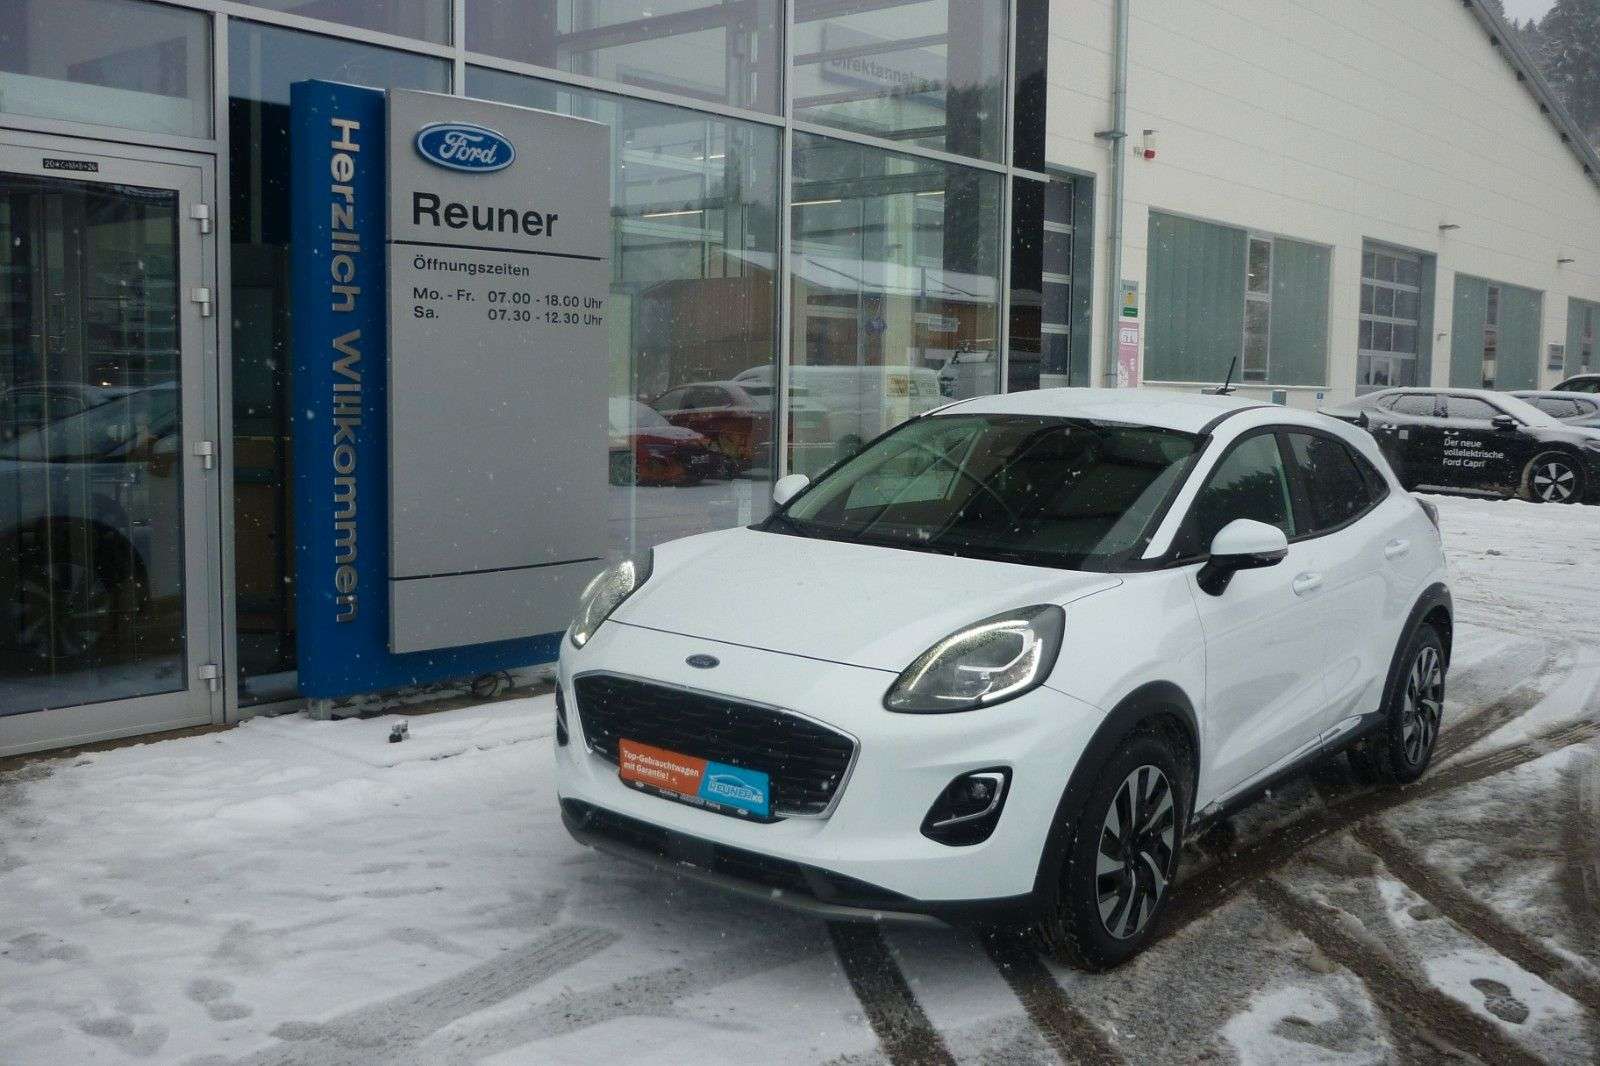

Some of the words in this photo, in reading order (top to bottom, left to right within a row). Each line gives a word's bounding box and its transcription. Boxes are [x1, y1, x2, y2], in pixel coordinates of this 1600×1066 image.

[439, 131, 498, 164] Ford
[330, 118, 360, 312] Herzlich
[412, 191, 558, 237] Reuner
[413, 254, 530, 277] Öffnungszeiten
[413, 287, 444, 301] Mo.
[457, 289, 475, 302] Fr.
[488, 290, 531, 305] 07.00
[545, 294, 580, 308] 18.00
[584, 299, 603, 310] Uhr
[413, 305, 439, 319] Sa.
[488, 309, 531, 322] 07.30
[545, 312, 580, 325] 12.30
[584, 316, 603, 326] Uhr
[1444, 438, 1458, 447] Der
[1460, 440, 1482, 448] neue
[1444, 449, 1504, 459] vollelektrische
[1443, 458, 1461, 466] Ford
[1463, 460, 1486, 469] Capri
[332, 329, 362, 622] Willkommen
[623, 762, 635, 771] mit
